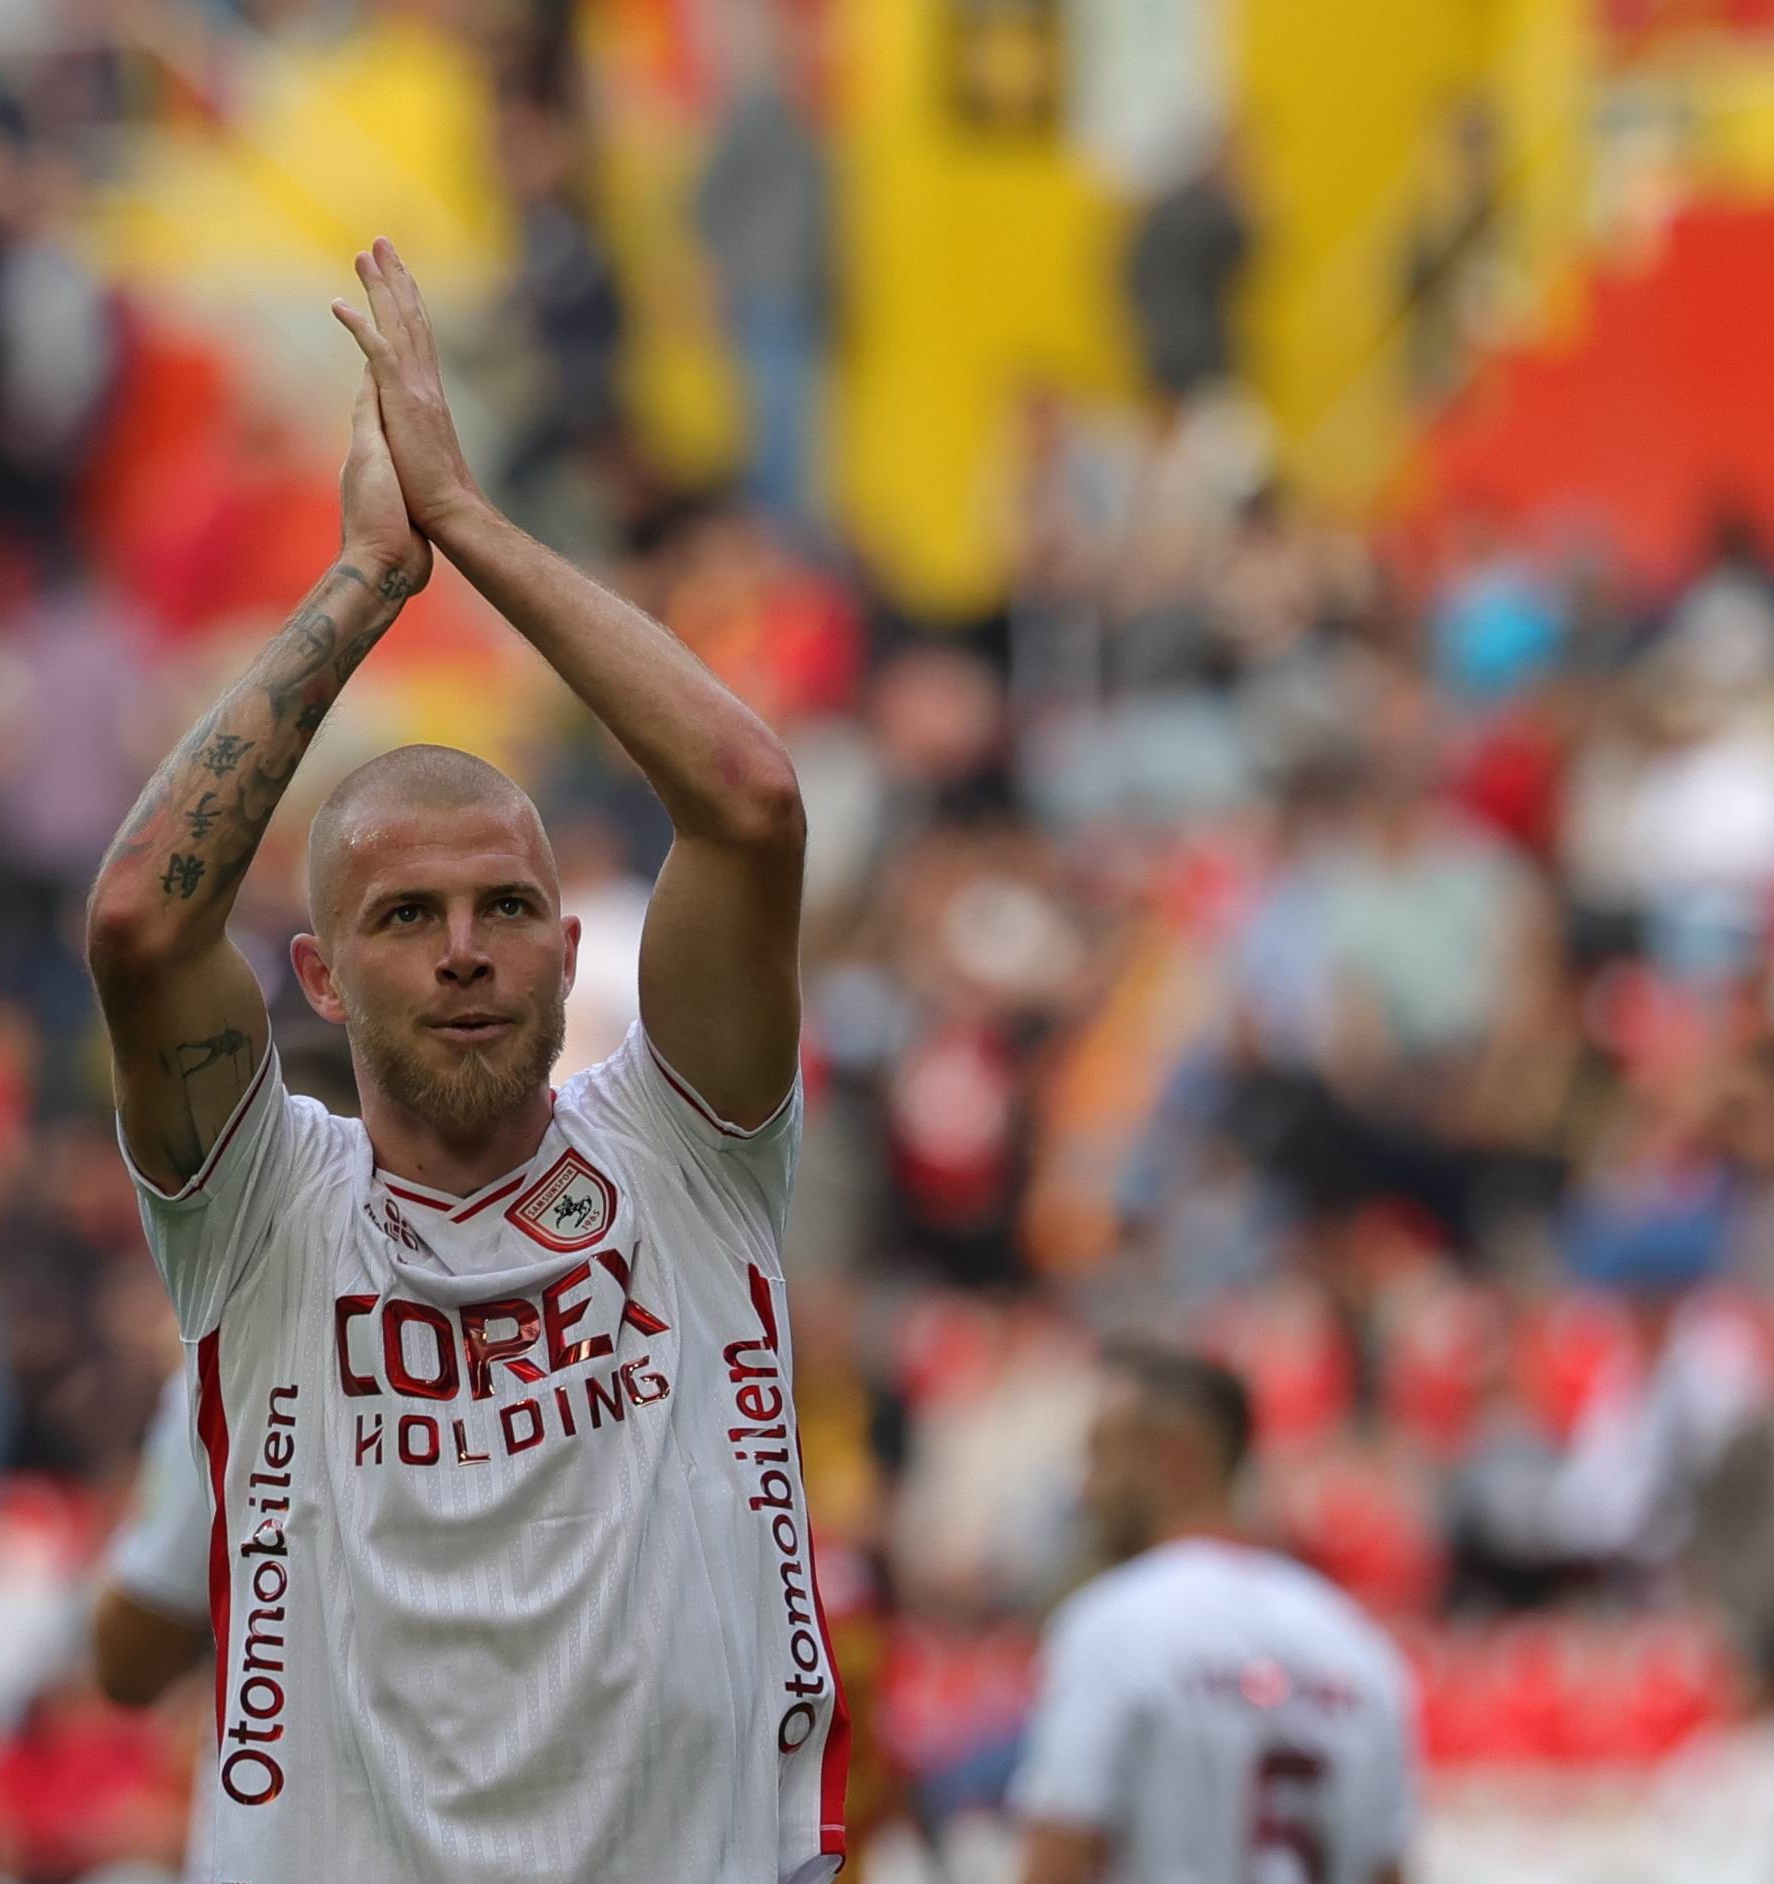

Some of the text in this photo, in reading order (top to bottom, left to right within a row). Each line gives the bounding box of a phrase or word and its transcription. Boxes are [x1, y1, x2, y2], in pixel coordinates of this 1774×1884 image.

[527, 1168, 575, 1217] SAMSUNSPOR
[581, 1208, 601, 1231] 1965
[334, 1247, 672, 1402] COREX
[354, 1354, 671, 1467] HOLDING
[221, 1384, 300, 1807] Otomobilen
[722, 1336, 825, 1757] Otomobilen
